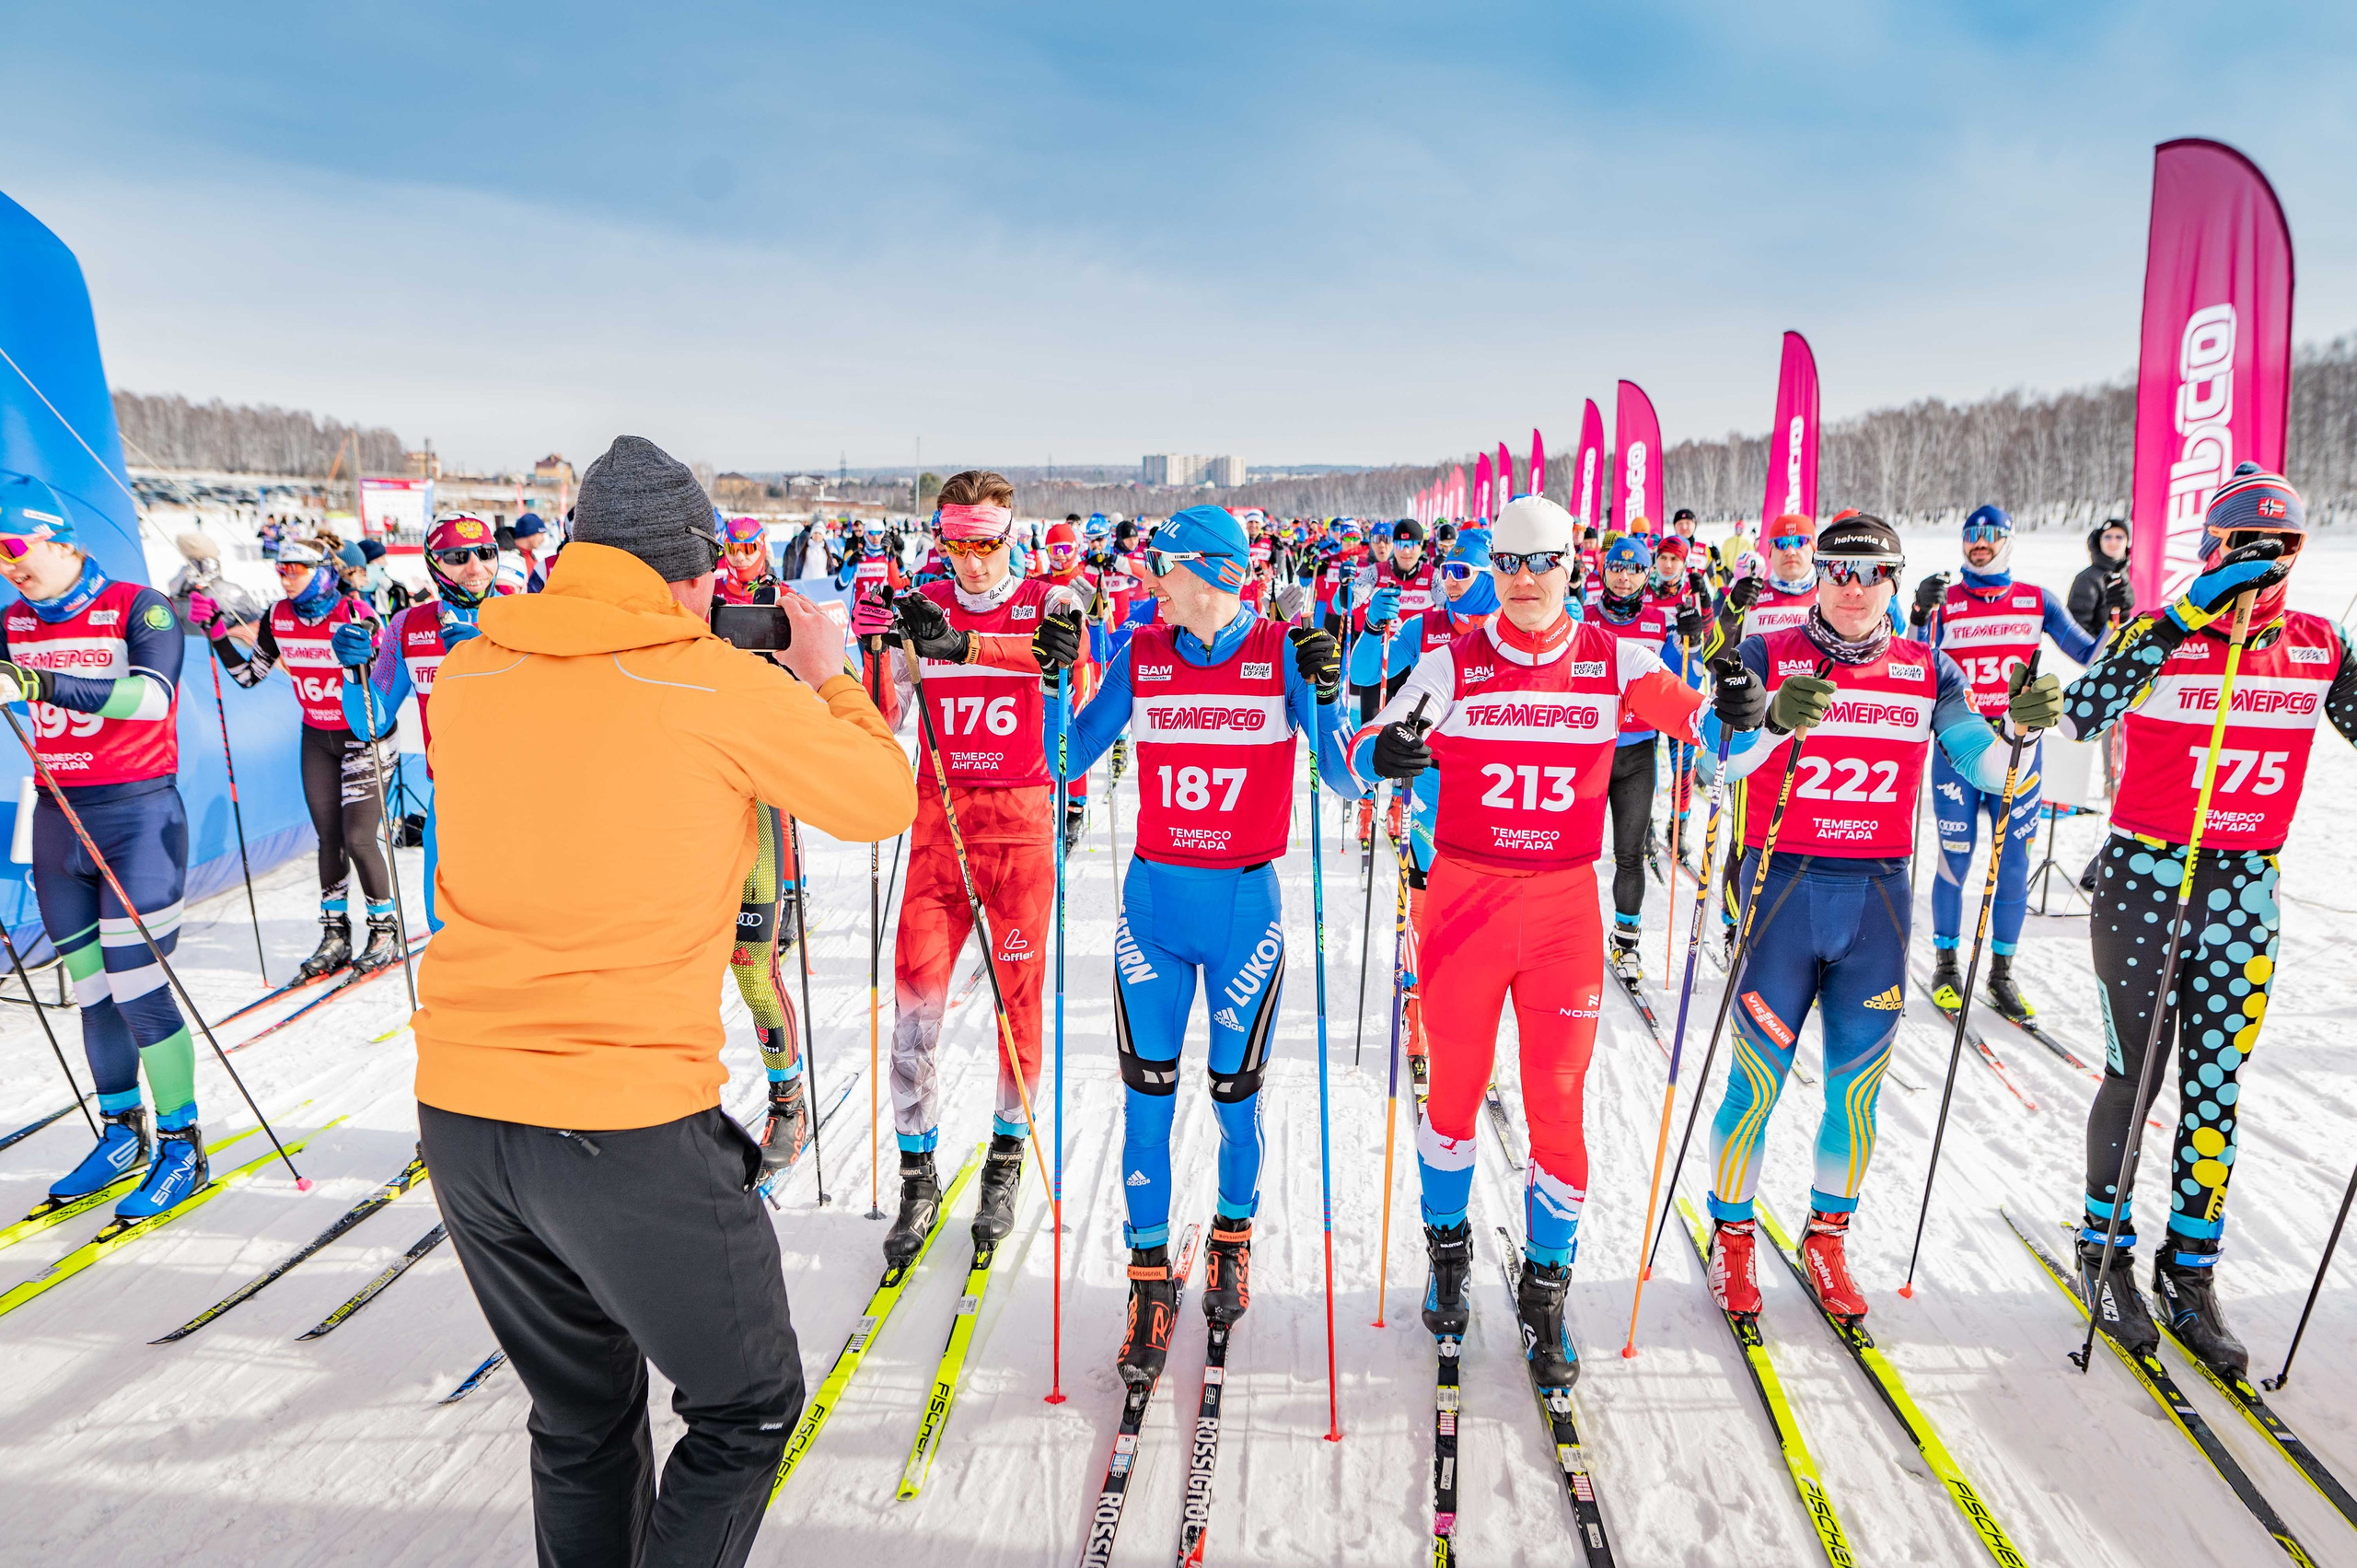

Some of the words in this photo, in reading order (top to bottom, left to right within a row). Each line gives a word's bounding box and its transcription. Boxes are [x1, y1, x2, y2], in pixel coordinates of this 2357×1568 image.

[1834, 534, 1879, 545] helvetia
[1758, 614, 1808, 626] ТЕМЕ
[1138, 664, 1173, 675] БАМ
[1462, 663, 1494, 679] БАМ
[1778, 659, 1813, 670] БАМ
[1961, 655, 2024, 685] 130
[1724, 676, 1747, 686] RAV
[1971, 691, 2010, 700] ТЕМЕРС
[939, 696, 1017, 736] 176
[1821, 702, 1919, 728] МЕРСО
[1392, 723, 1415, 745] RAV
[952, 761, 1000, 771] АНГАРА
[1308, 749, 1318, 791] KV+
[1795, 756, 1898, 803] 222
[2189, 745, 2291, 796] 175
[1156, 765, 1248, 812] 187
[1480, 762, 1576, 812] 213
[1780, 770, 1794, 807] START
[2001, 766, 2019, 805] START
[1172, 838, 1226, 851] АНГАРА
[1494, 838, 1554, 851] АНГАРА
[1817, 828, 1874, 841] АНГАРА
[1863, 997, 1903, 1012] adidas
[1213, 1012, 1245, 1033] adidas
[151, 1148, 197, 1207] SPINE
[1126, 1177, 1151, 1187] adidas
[43, 1190, 110, 1226] FISCHER
[113, 1210, 172, 1249] FISCHER
[1809, 1246, 1831, 1290] alpina
[324, 1268, 396, 1327] FISCHER
[2108, 1340, 2153, 1390] FISCHER
[2194, 1360, 2247, 1416] FISCHER
[1947, 1478, 2024, 1568] FISCHE
